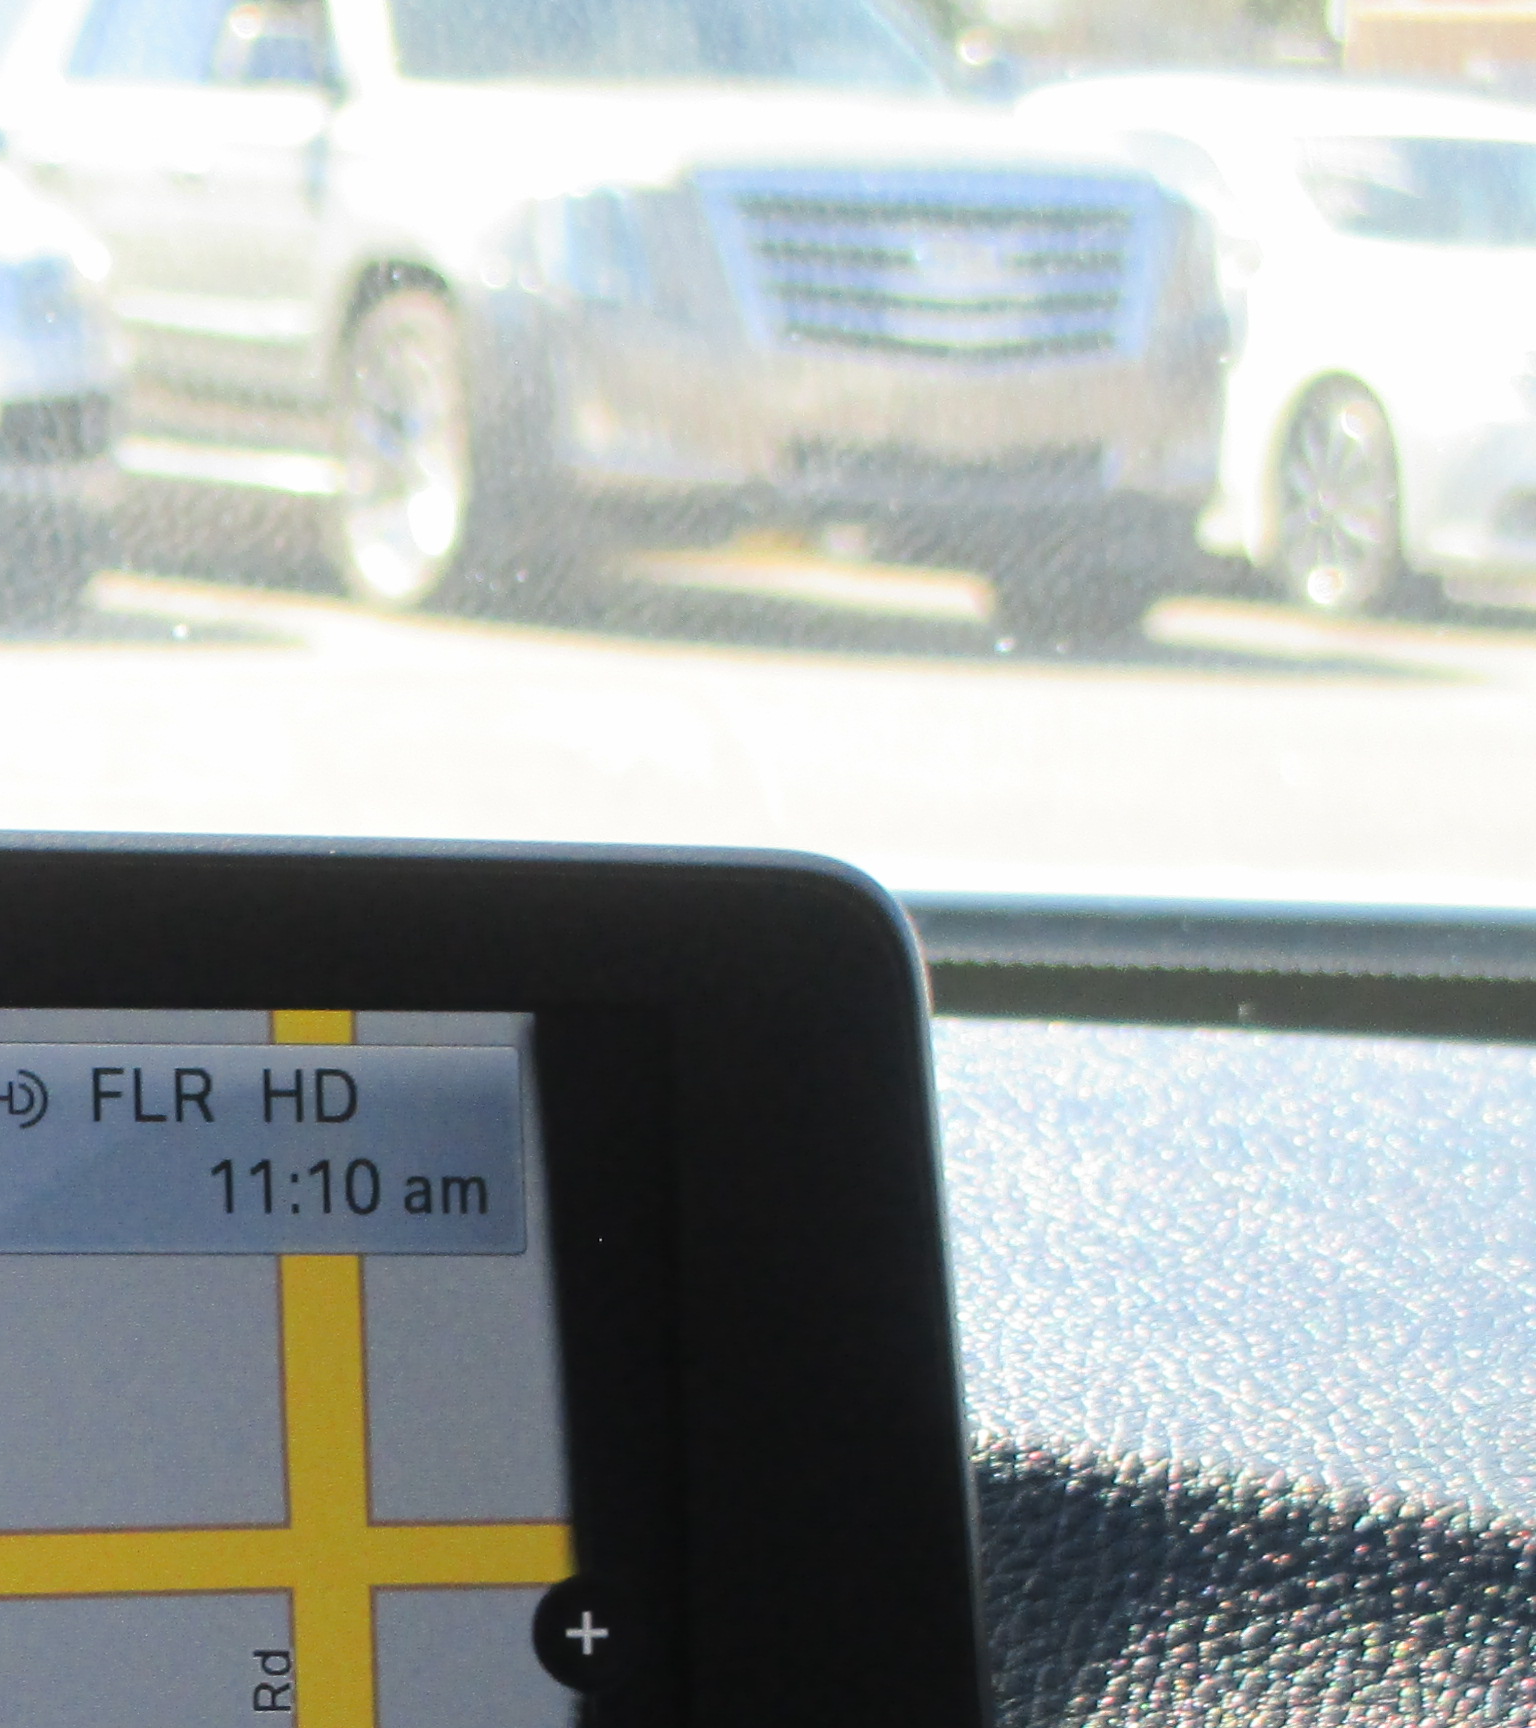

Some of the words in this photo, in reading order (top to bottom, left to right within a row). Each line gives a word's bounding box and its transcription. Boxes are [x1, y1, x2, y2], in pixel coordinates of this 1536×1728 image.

[91, 1067, 216, 1123] FLR
[262, 1068, 358, 1123] HD
[210, 1158, 381, 1215] 11:10
[403, 1173, 489, 1215] am
[252, 1648, 293, 1712] Rd
